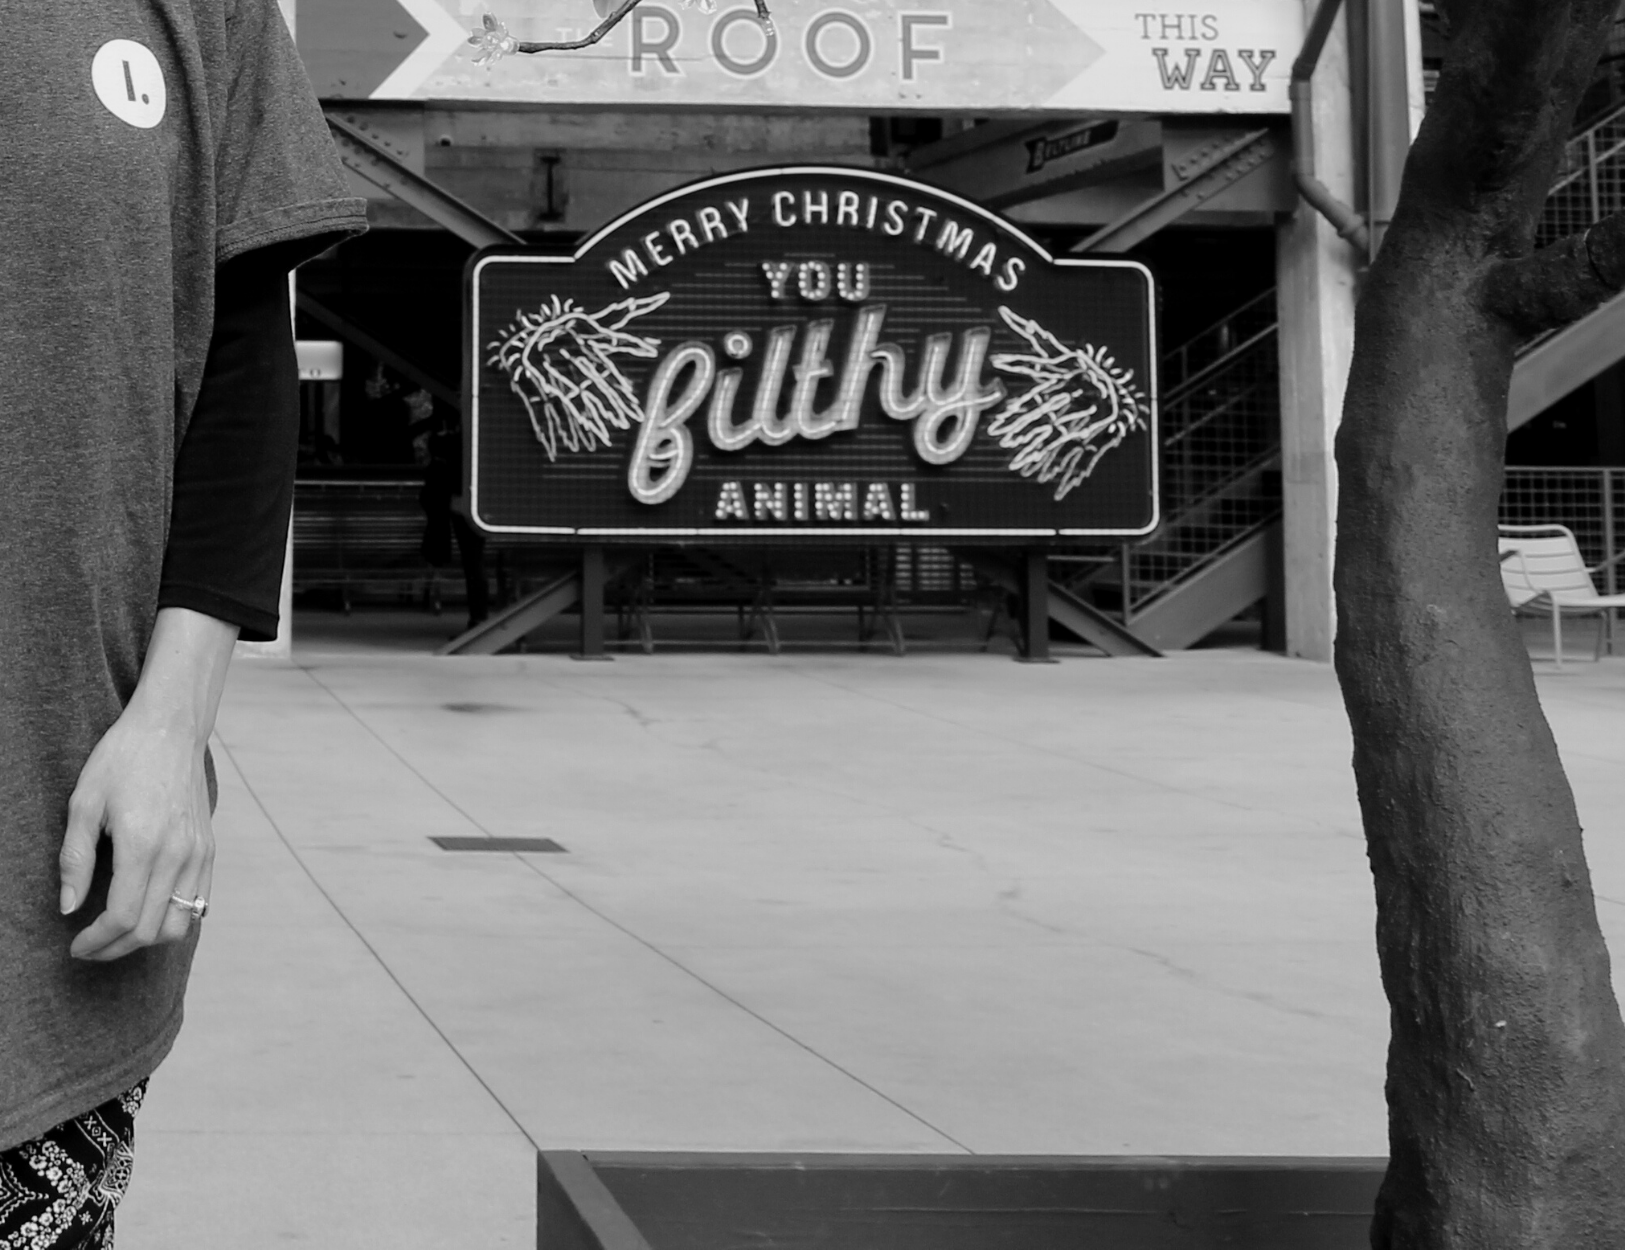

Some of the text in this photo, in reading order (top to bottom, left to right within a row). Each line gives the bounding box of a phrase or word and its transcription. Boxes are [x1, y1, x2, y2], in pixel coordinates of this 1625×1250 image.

[630, 4, 950, 81] ROOF
[1134, 13, 1219, 41] THIS
[1152, 48, 1277, 92] WAY
[609, 190, 1026, 292] MERRY CHRISTMAS
[762, 261, 871, 301] YOU
[628, 304, 1009, 505] filthy
[715, 481, 930, 521] ANIMAL
